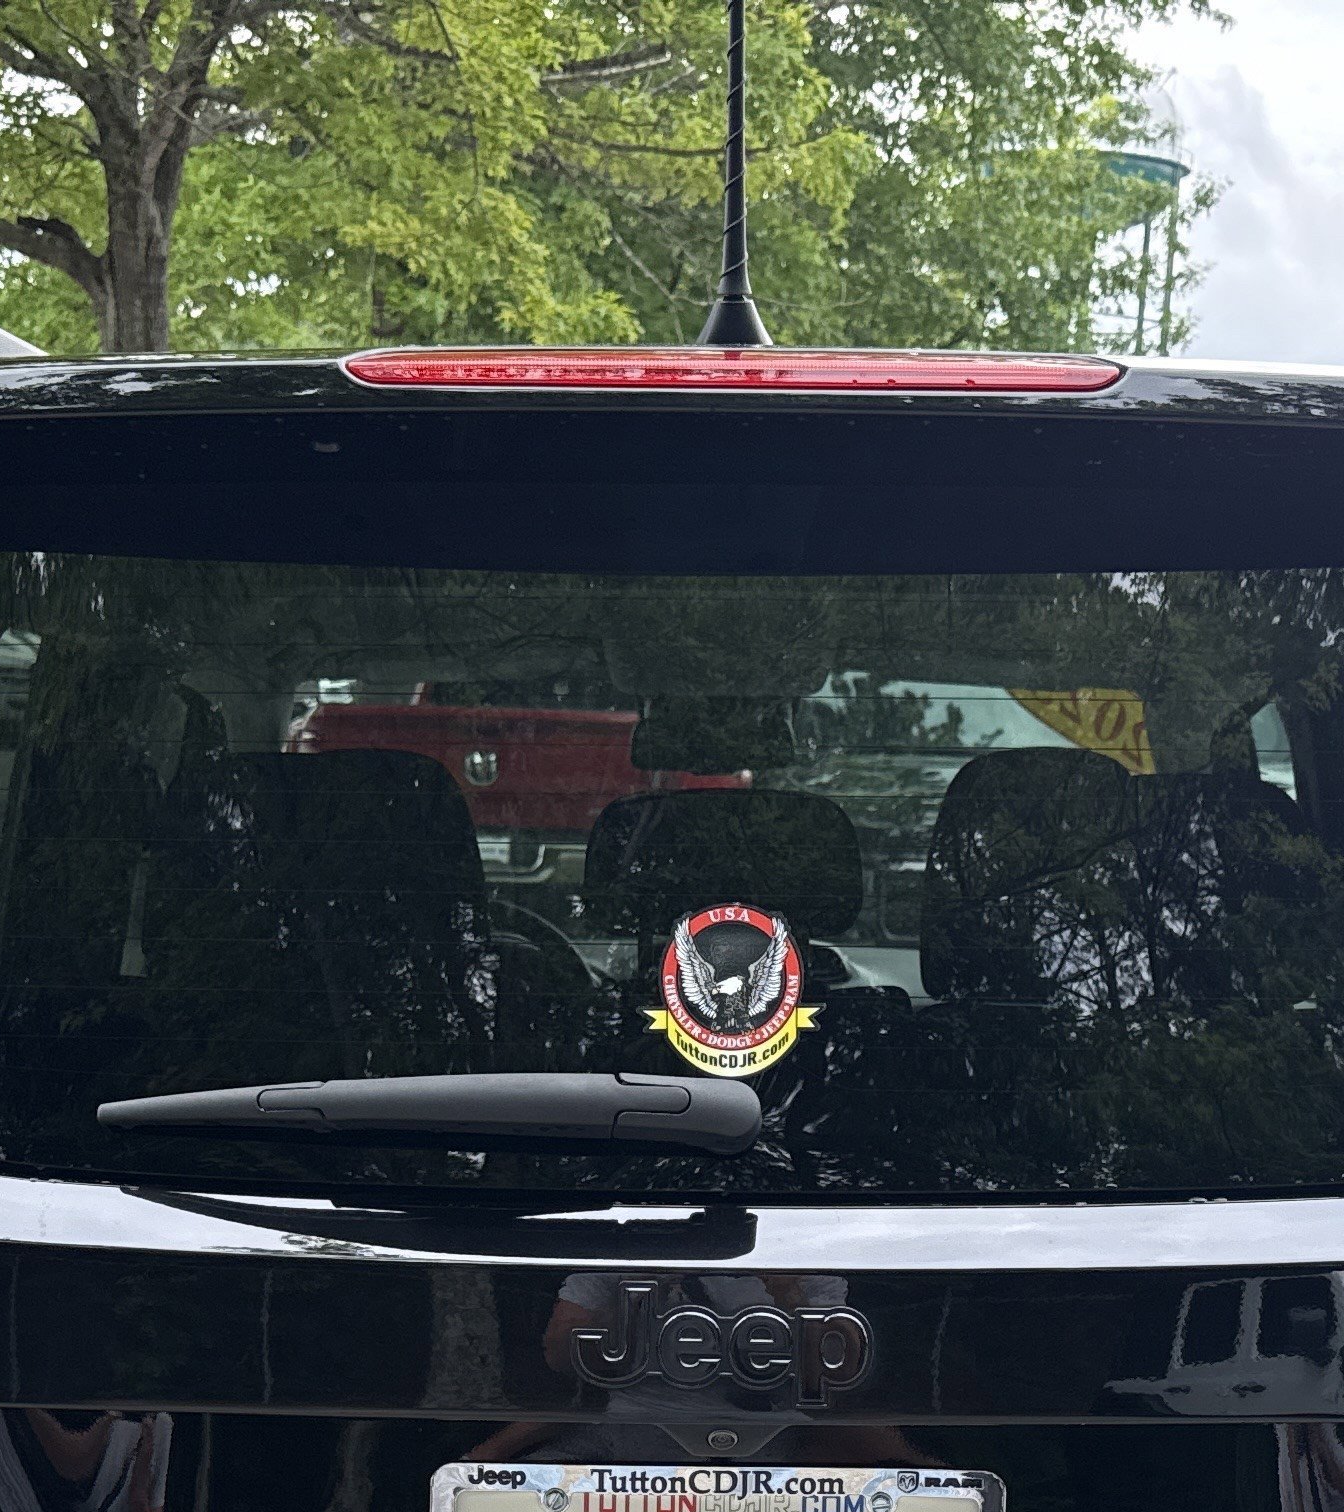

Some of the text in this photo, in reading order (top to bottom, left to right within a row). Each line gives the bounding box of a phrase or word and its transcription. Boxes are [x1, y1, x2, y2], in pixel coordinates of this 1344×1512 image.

[708, 908, 751, 922] USA
[664, 974, 799, 1048] CHRYSLER DODGE JEEP RAM
[674, 1030, 789, 1069] TuttonCDJR.com
[570, 1280, 874, 1408] Jeep
[468, 1466, 527, 1489] Jeep
[590, 1468, 845, 1498] TuttonCDJR.com
[924, 1477, 984, 1489] RAM
